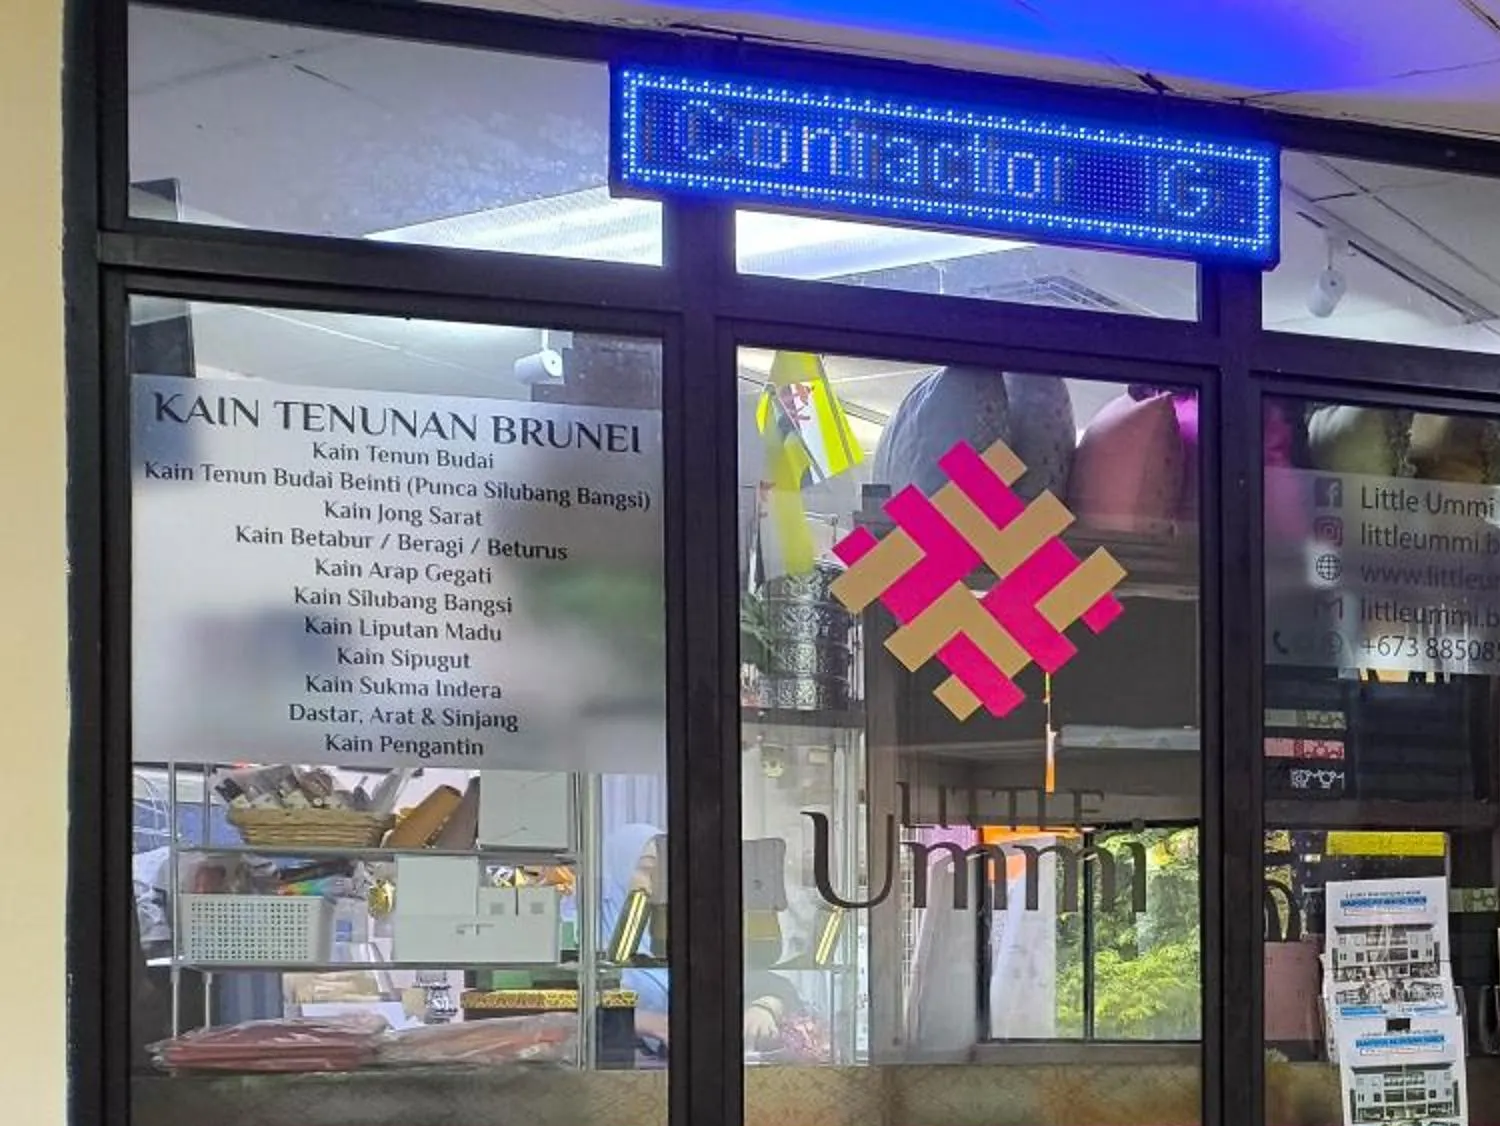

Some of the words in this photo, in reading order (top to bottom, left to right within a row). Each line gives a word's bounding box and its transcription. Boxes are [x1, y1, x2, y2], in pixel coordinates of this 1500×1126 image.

[153, 391, 260, 428] KAIN
[273, 400, 478, 441] TENUNAN
[491, 415, 642, 454] BRUNEI
[312, 441, 359, 461] Kain
[366, 444, 430, 466] Tenun
[436, 449, 495, 469] Budai
[144, 460, 194, 482] Kain
[200, 462, 267, 486] Tenun
[273, 466, 334, 489] Budai
[340, 471, 401, 493] Beinti
[406, 475, 478, 498] (Punca
[484, 480, 571, 509] Silubang
[577, 487, 651, 512] Bangsi)
[324, 499, 371, 521] Kain
[377, 502, 423, 527] Jong
[429, 505, 484, 527] Sarat
[1360, 484, 1420, 513] Little
[1425, 489, 1495, 519] Ummi
[235, 524, 283, 546] Kain
[290, 527, 374, 549] Betabur
[379, 532, 391, 550] /
[398, 533, 464, 559] Beragi
[470, 537, 481, 555] /
[487, 538, 569, 561] Beturus
[314, 556, 362, 579] Kain
[368, 560, 419, 584] Arap
[425, 562, 493, 588] Gegati
[294, 585, 341, 606] Kain
[347, 587, 438, 615] Silubang
[444, 592, 513, 618] Bangsi
[304, 614, 352, 636] Kain
[359, 617, 439, 640] Liputan
[445, 622, 503, 642] Madu
[336, 646, 385, 666] Kain
[391, 647, 473, 673] Sipugut
[1361, 634, 1418, 657] +673
[305, 673, 353, 694] Kain
[358, 674, 429, 697] Sukma
[436, 678, 503, 699] Indera
[288, 702, 364, 725] Dastar,
[369, 706, 418, 726] Arat
[421, 706, 436, 726] &
[441, 707, 519, 733] Sinjang
[324, 732, 373, 753] Kain
[380, 734, 485, 759] Pengantin
